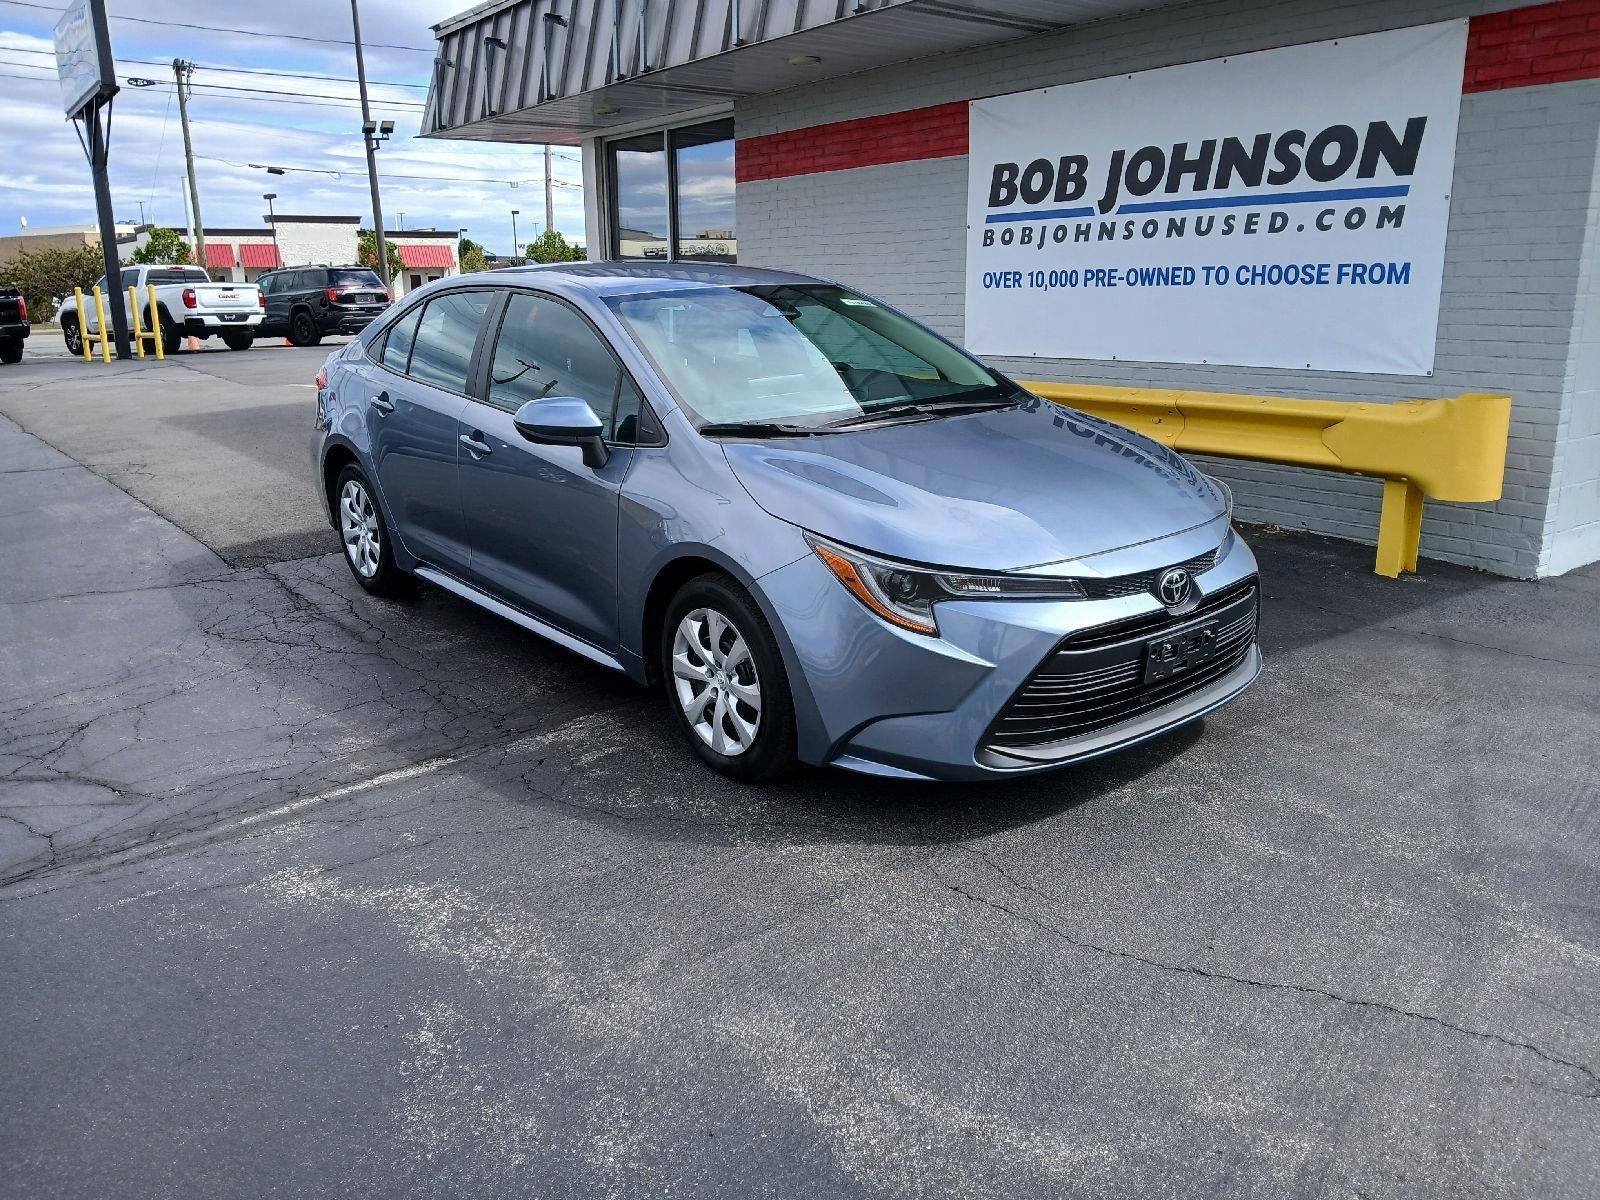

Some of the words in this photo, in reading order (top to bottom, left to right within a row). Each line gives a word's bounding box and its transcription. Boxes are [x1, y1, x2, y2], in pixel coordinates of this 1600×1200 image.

[987, 154, 1089, 208] BOB
[1097, 116, 1428, 215] JOHNSON
[982, 204, 1406, 251] BOBJOHNSONUSED.COM
[982, 270, 1023, 289] OVER
[1027, 268, 1079, 292] 10,000
[1081, 264, 1198, 289] PRE-OWNED
[1199, 263, 1232, 288] TO
[1234, 261, 1332, 288] CHOOSE
[1335, 259, 1413, 288] FROM
